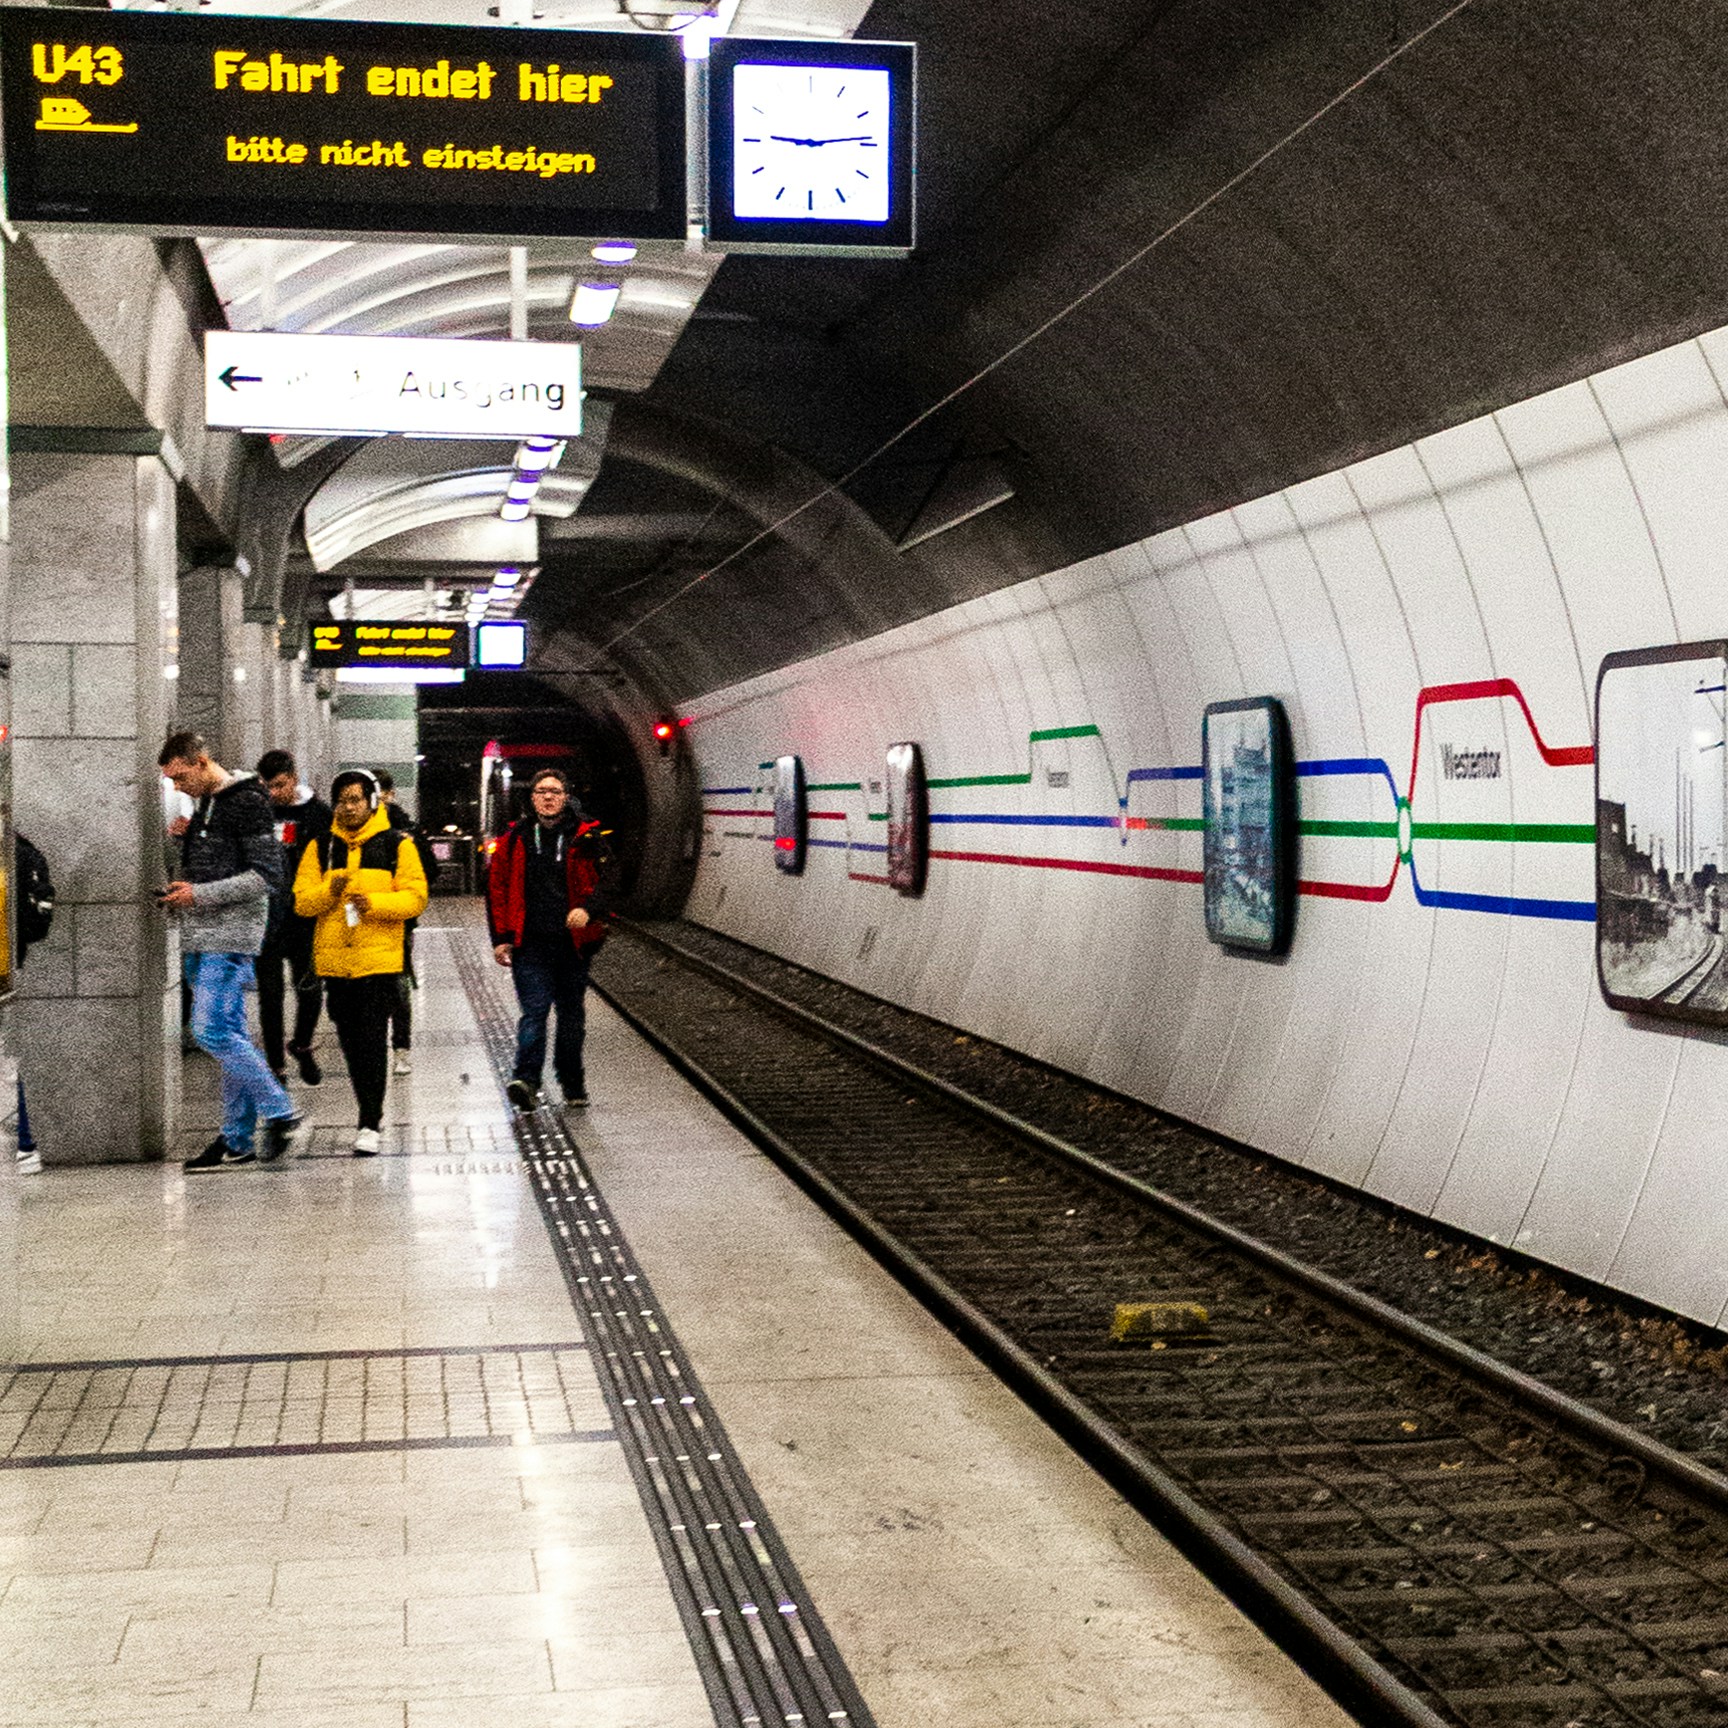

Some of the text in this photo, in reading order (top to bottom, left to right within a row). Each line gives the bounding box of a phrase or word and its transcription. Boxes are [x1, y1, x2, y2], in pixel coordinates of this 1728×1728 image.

[32, 43, 124, 86] U43
[213, 50, 614, 104] Fahrt endet hier
[226, 135, 596, 178] bitte nicht einsteigen
